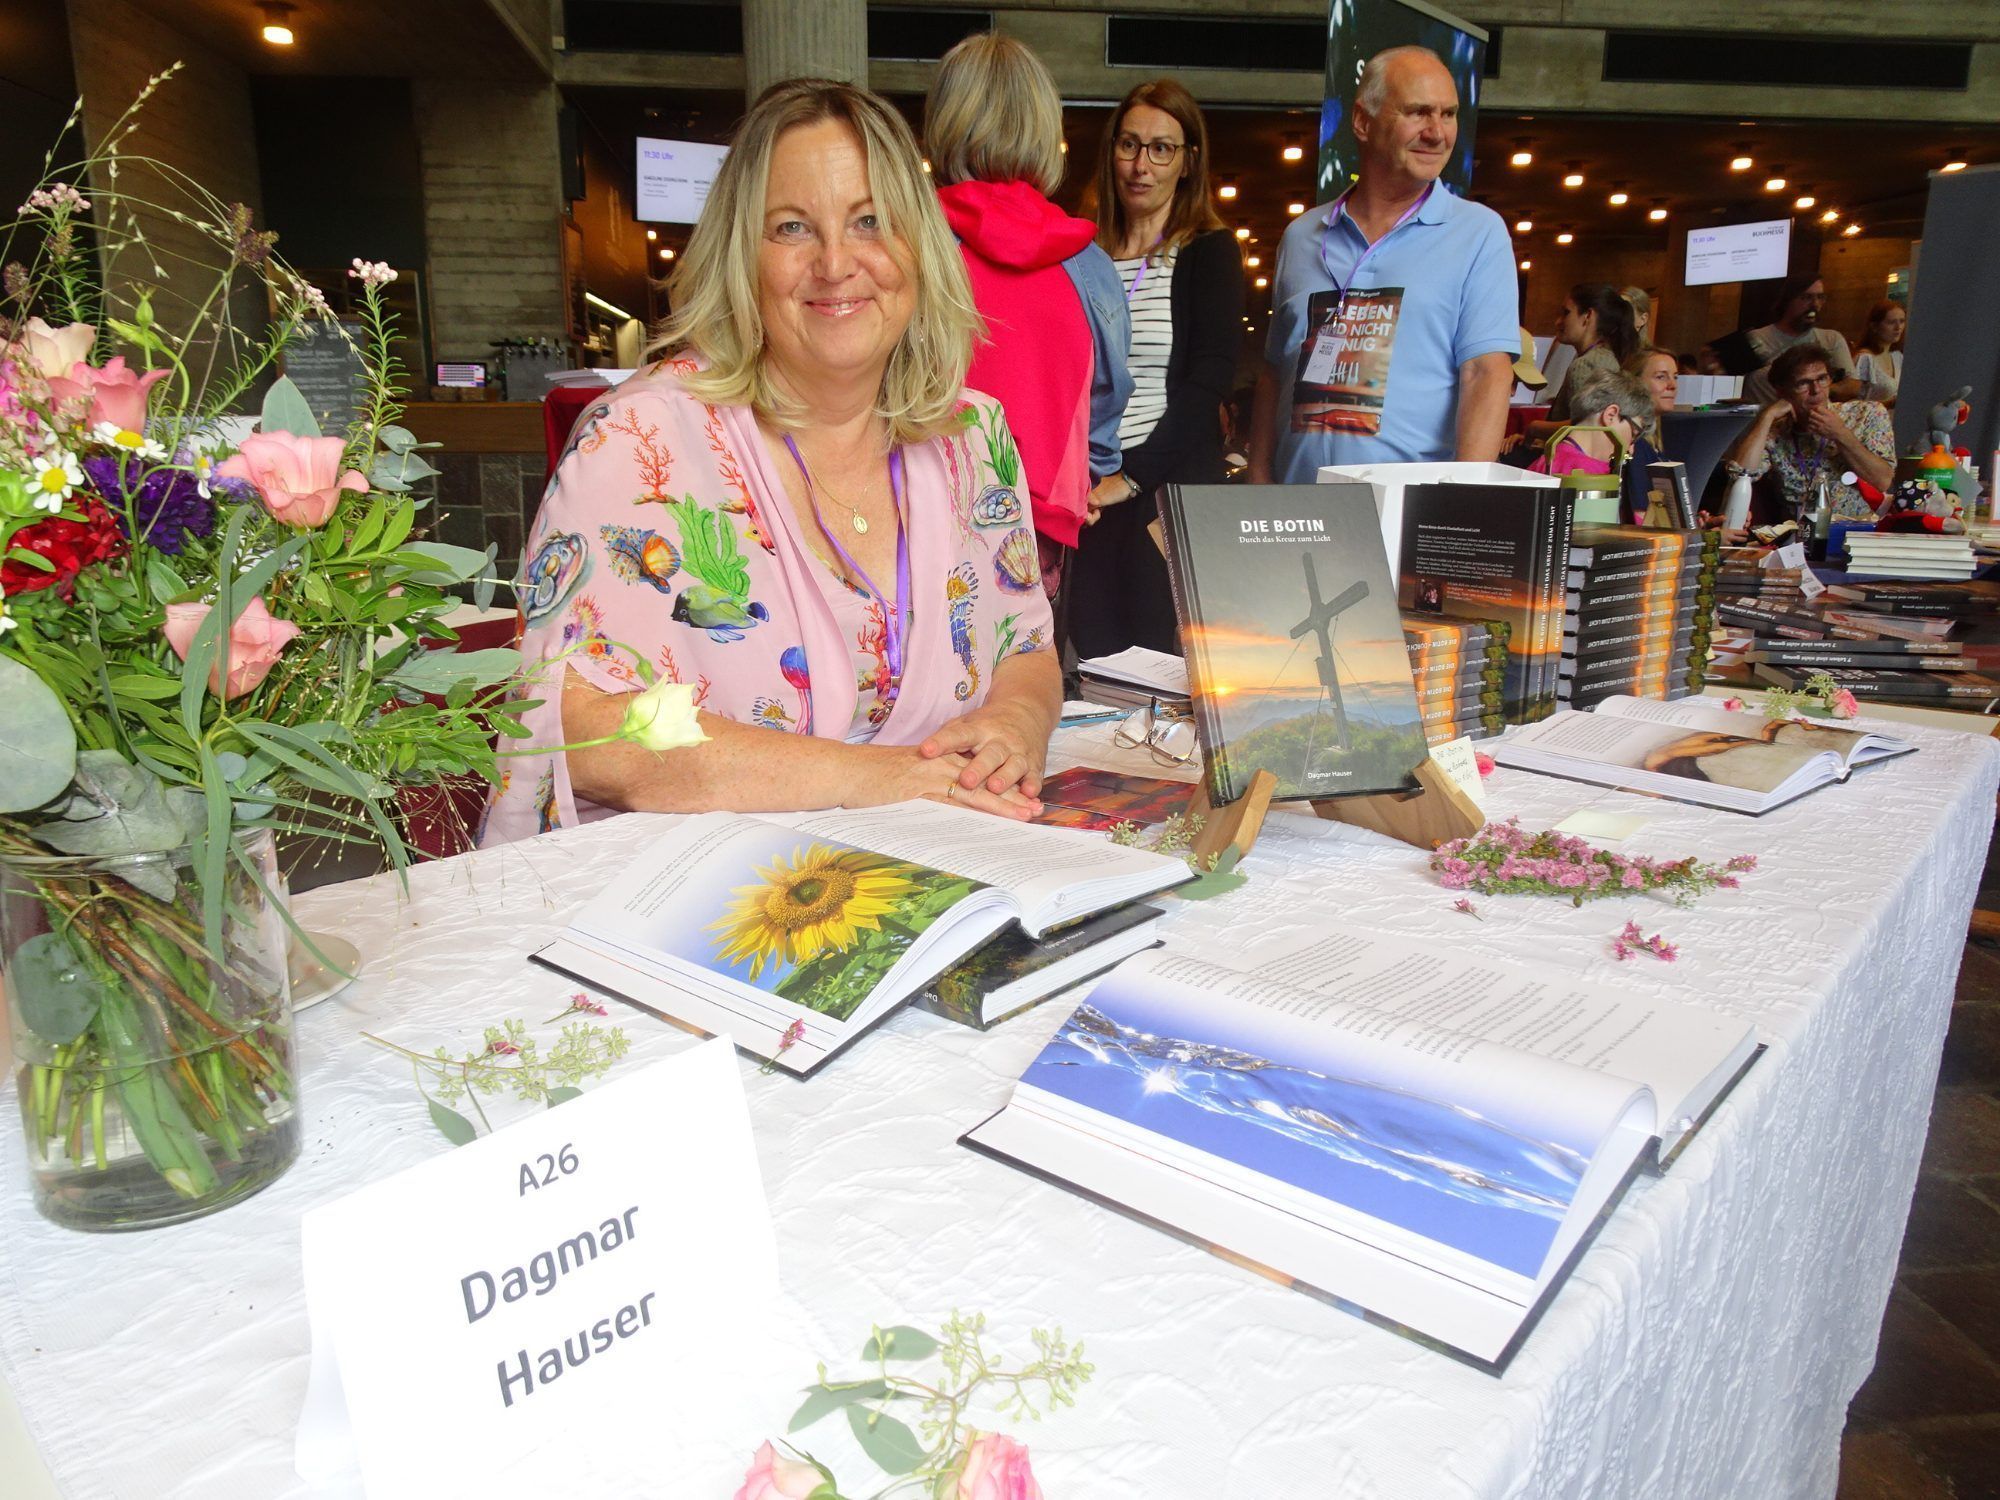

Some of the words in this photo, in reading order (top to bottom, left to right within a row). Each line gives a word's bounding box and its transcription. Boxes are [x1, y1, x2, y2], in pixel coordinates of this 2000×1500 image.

[1752, 229, 1784, 237] BUCHMESSE
[1324, 307, 1336, 323] 7
[1338, 304, 1394, 321] LEBEN
[1350, 322, 1393, 337] NICHT
[1341, 337, 1376, 352] NUG
[1240, 520, 1270, 533] DIE
[1273, 519, 1325, 532] BOTIN
[1276, 535, 1295, 543] Kreuz
[1313, 534, 1331, 542] Licht
[1545, 544, 1553, 566] KREUZ
[1561, 542, 1569, 564] KREUZ
[1307, 772, 1331, 780] Dagmar
[518, 1143, 580, 1197] A26
[460, 1206, 639, 1324] Dagmar
[497, 1292, 655, 1407] Hauser
